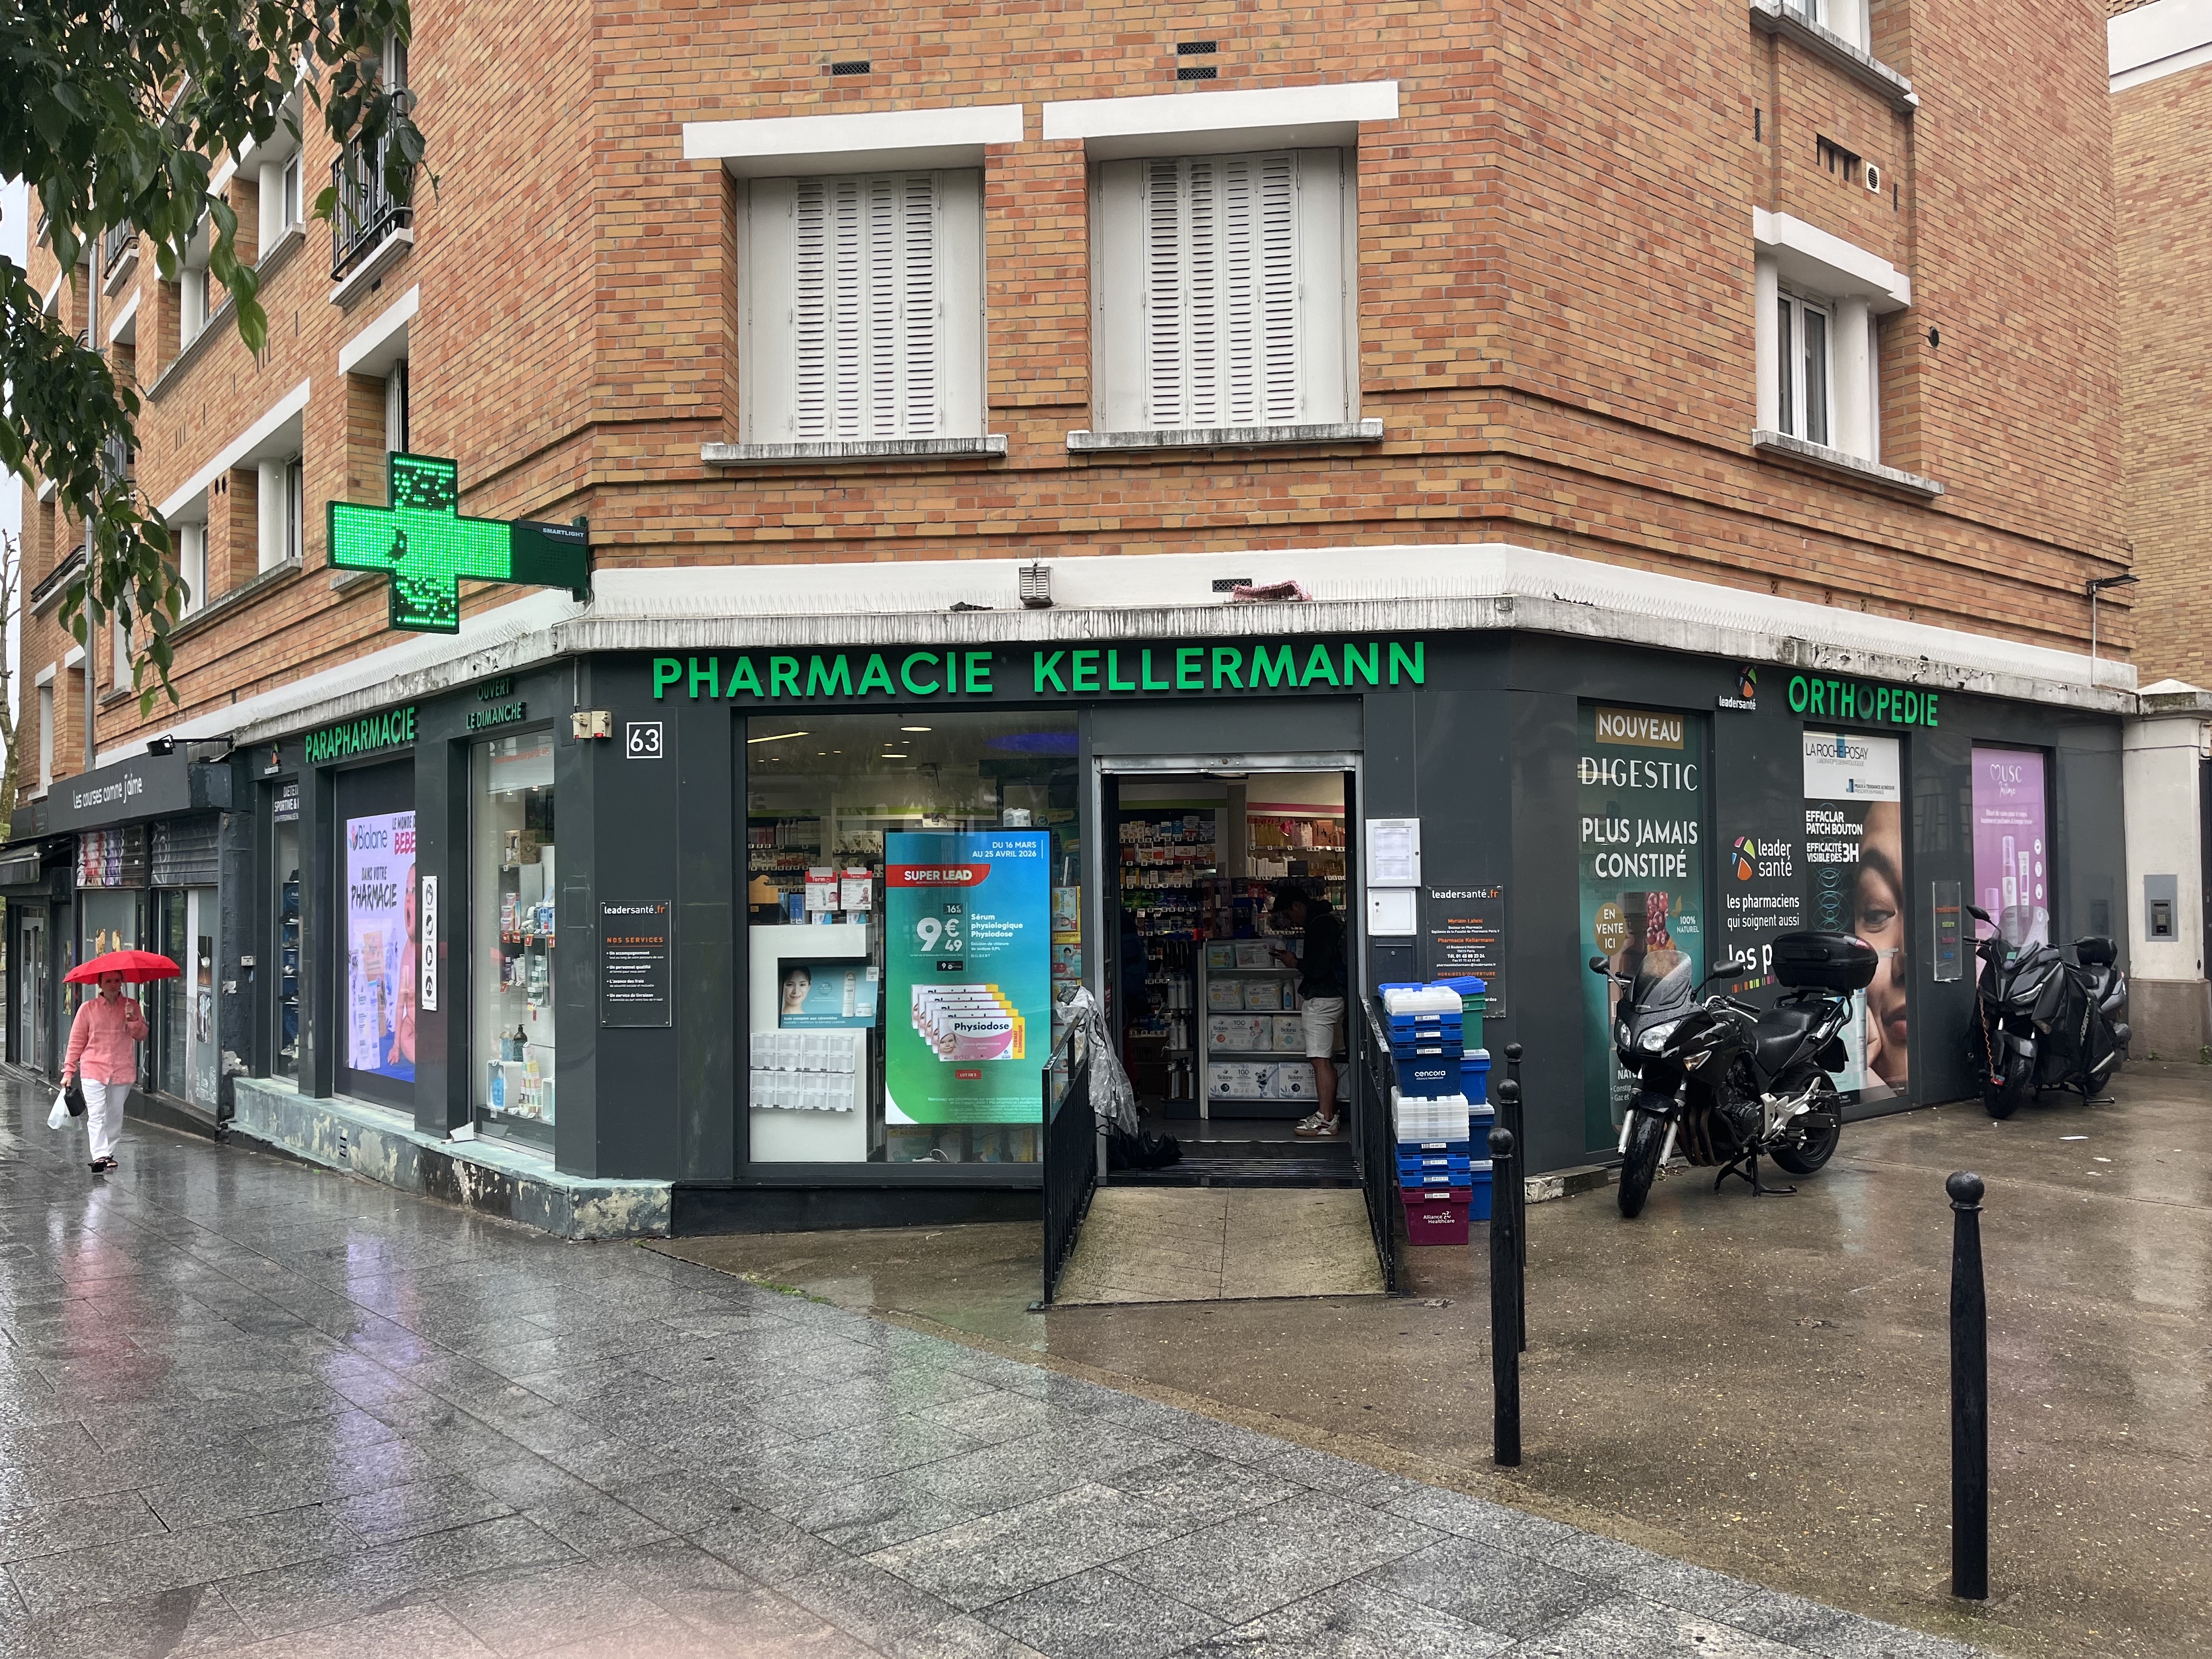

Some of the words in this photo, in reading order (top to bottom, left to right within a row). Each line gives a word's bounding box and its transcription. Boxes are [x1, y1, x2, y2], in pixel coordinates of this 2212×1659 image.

[543, 528, 584, 537] SMARTLIGHT
[653, 651, 993, 698] PHARMACIE
[1034, 641, 1425, 693] KELLERMANN
[477, 678, 510, 701] OUVERT
[1719, 695, 1756, 710] leadersanté
[1789, 675, 1939, 726] ORTHOPEDIE
[466, 713, 475, 730] LE
[477, 702, 522, 727] DIMANCHE
[306, 707, 415, 763] PARAPHARMACIE
[1599, 714, 1681, 742] NOUVEAU
[630, 729, 659, 752] 63
[1805, 743, 1816, 757] LA
[1817, 743, 1844, 758] ROCHE
[1845, 746, 1869, 760] POSAY
[1581, 757, 1699, 791] DIGESTIC
[73, 790, 82, 809] Les
[82, 788, 103, 807] courses
[103, 782, 122, 802] comme
[392, 817, 397, 830] LE
[397, 815, 412, 831] MONDE
[1805, 810, 1844, 823] EFFACLAR
[358, 823, 387, 850] Biolane
[1582, 817, 1630, 843] PLUS
[1636, 819, 1699, 847] JAMAIS
[1806, 823, 1830, 835] PATCH
[1832, 823, 1863, 835] BOUTON
[1758, 839, 1792, 856] leader
[1807, 840, 1842, 853] EFFICACITÉ
[1807, 853, 1830, 863] VISIBLE
[1842, 843, 1860, 863] 3H
[1595, 849, 1687, 878] CONSTIPÉ
[1759, 856, 1792, 877] santé
[362, 867, 373, 881] DANS
[374, 866, 387, 881] VOTRE
[904, 871, 940, 881] SUPER
[943, 870, 973, 881] LEAD
[351, 883, 397, 911] PHARMACIE
[1432, 889, 1499, 899] leadersanté.fr
[1726, 894, 1740, 909] les
[1742, 893, 1799, 912] pharmaciens
[604, 905, 665, 914] leadersanté.fr
[1604, 909, 1616, 920] EN
[945, 918, 960, 938] €
[971, 922, 1023, 930] physiologique
[1596, 923, 1624, 934] VENTE
[1677, 925, 1700, 933] NATUREL
[1679, 916, 1696, 925] 100%
[1728, 913, 1740, 932] qui
[1742, 913, 1778, 931] soignent
[1779, 912, 1799, 926] aussi
[917, 917, 943, 951] 9
[971, 930, 1013, 939] Physiodose
[945, 939, 963, 951] 49
[1605, 938, 1616, 949] ICI
[1729, 944, 1757, 970] les
[1762, 944, 1773, 975] p
[954, 1022, 1009, 1032] Physiodose
